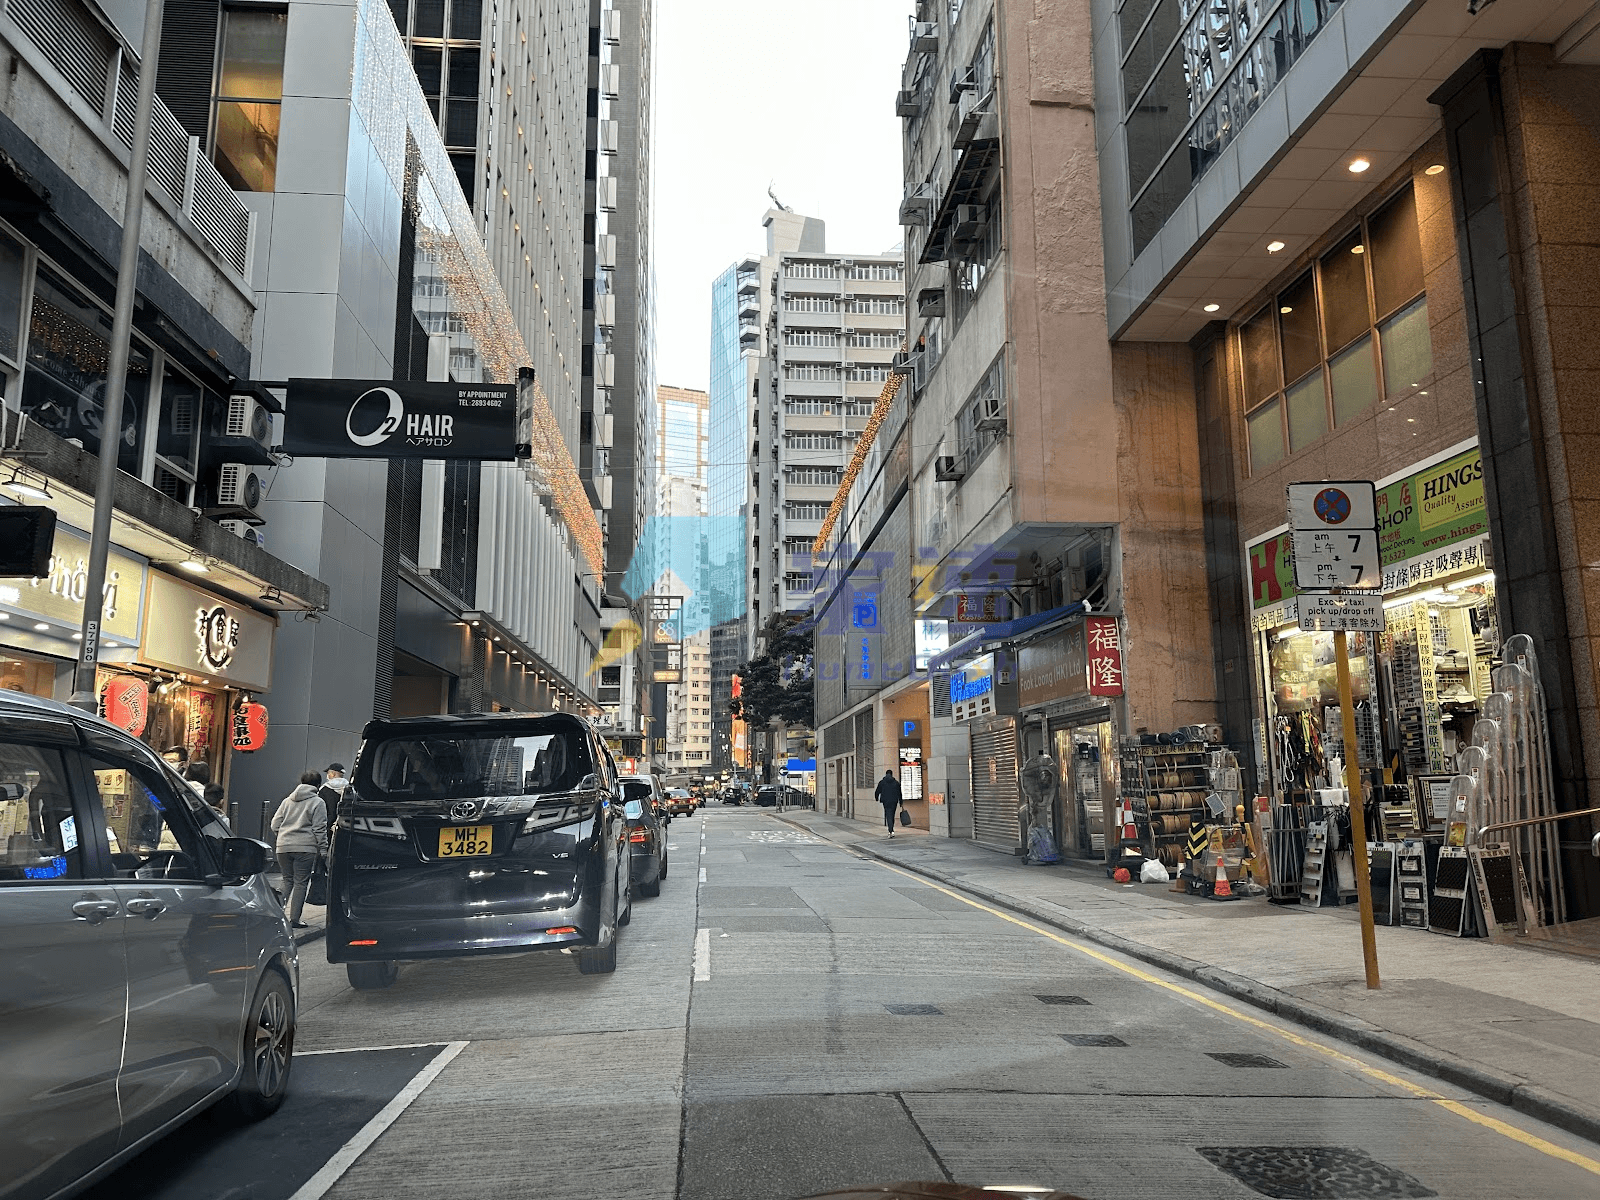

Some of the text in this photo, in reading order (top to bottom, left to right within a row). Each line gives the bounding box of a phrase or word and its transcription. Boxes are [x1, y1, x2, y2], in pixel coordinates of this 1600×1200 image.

[458, 390, 508, 399] BY APPOINTMENT
[406, 414, 453, 437] HAIR
[405, 437, 452, 447] ヘアサロン
[1424, 494, 1456, 513] Quality
[1312, 542, 1335, 553] 上午
[1347, 534, 1361, 553] 7
[1317, 564, 1333, 572] pm
[1350, 565, 1364, 584] 7
[1313, 573, 1338, 584] 下午
[960, 595, 995, 613] 福隆
[1349, 598, 1364, 606] taxi
[1308, 607, 1375, 616] pick up/drop off
[657, 622, 674, 636] 88
[1304, 617, 1380, 628] 的士上落客除外
[85, 623, 97, 661] 37790
[1089, 622, 1121, 688] 福隆
[1020, 674, 1035, 692] Fook
[1034, 671, 1052, 688] Loong
[1069, 658, 1083, 676] Ltd.
[903, 721, 916, 737] P
[455, 827, 478, 842] MH
[442, 841, 489, 856] 3482
